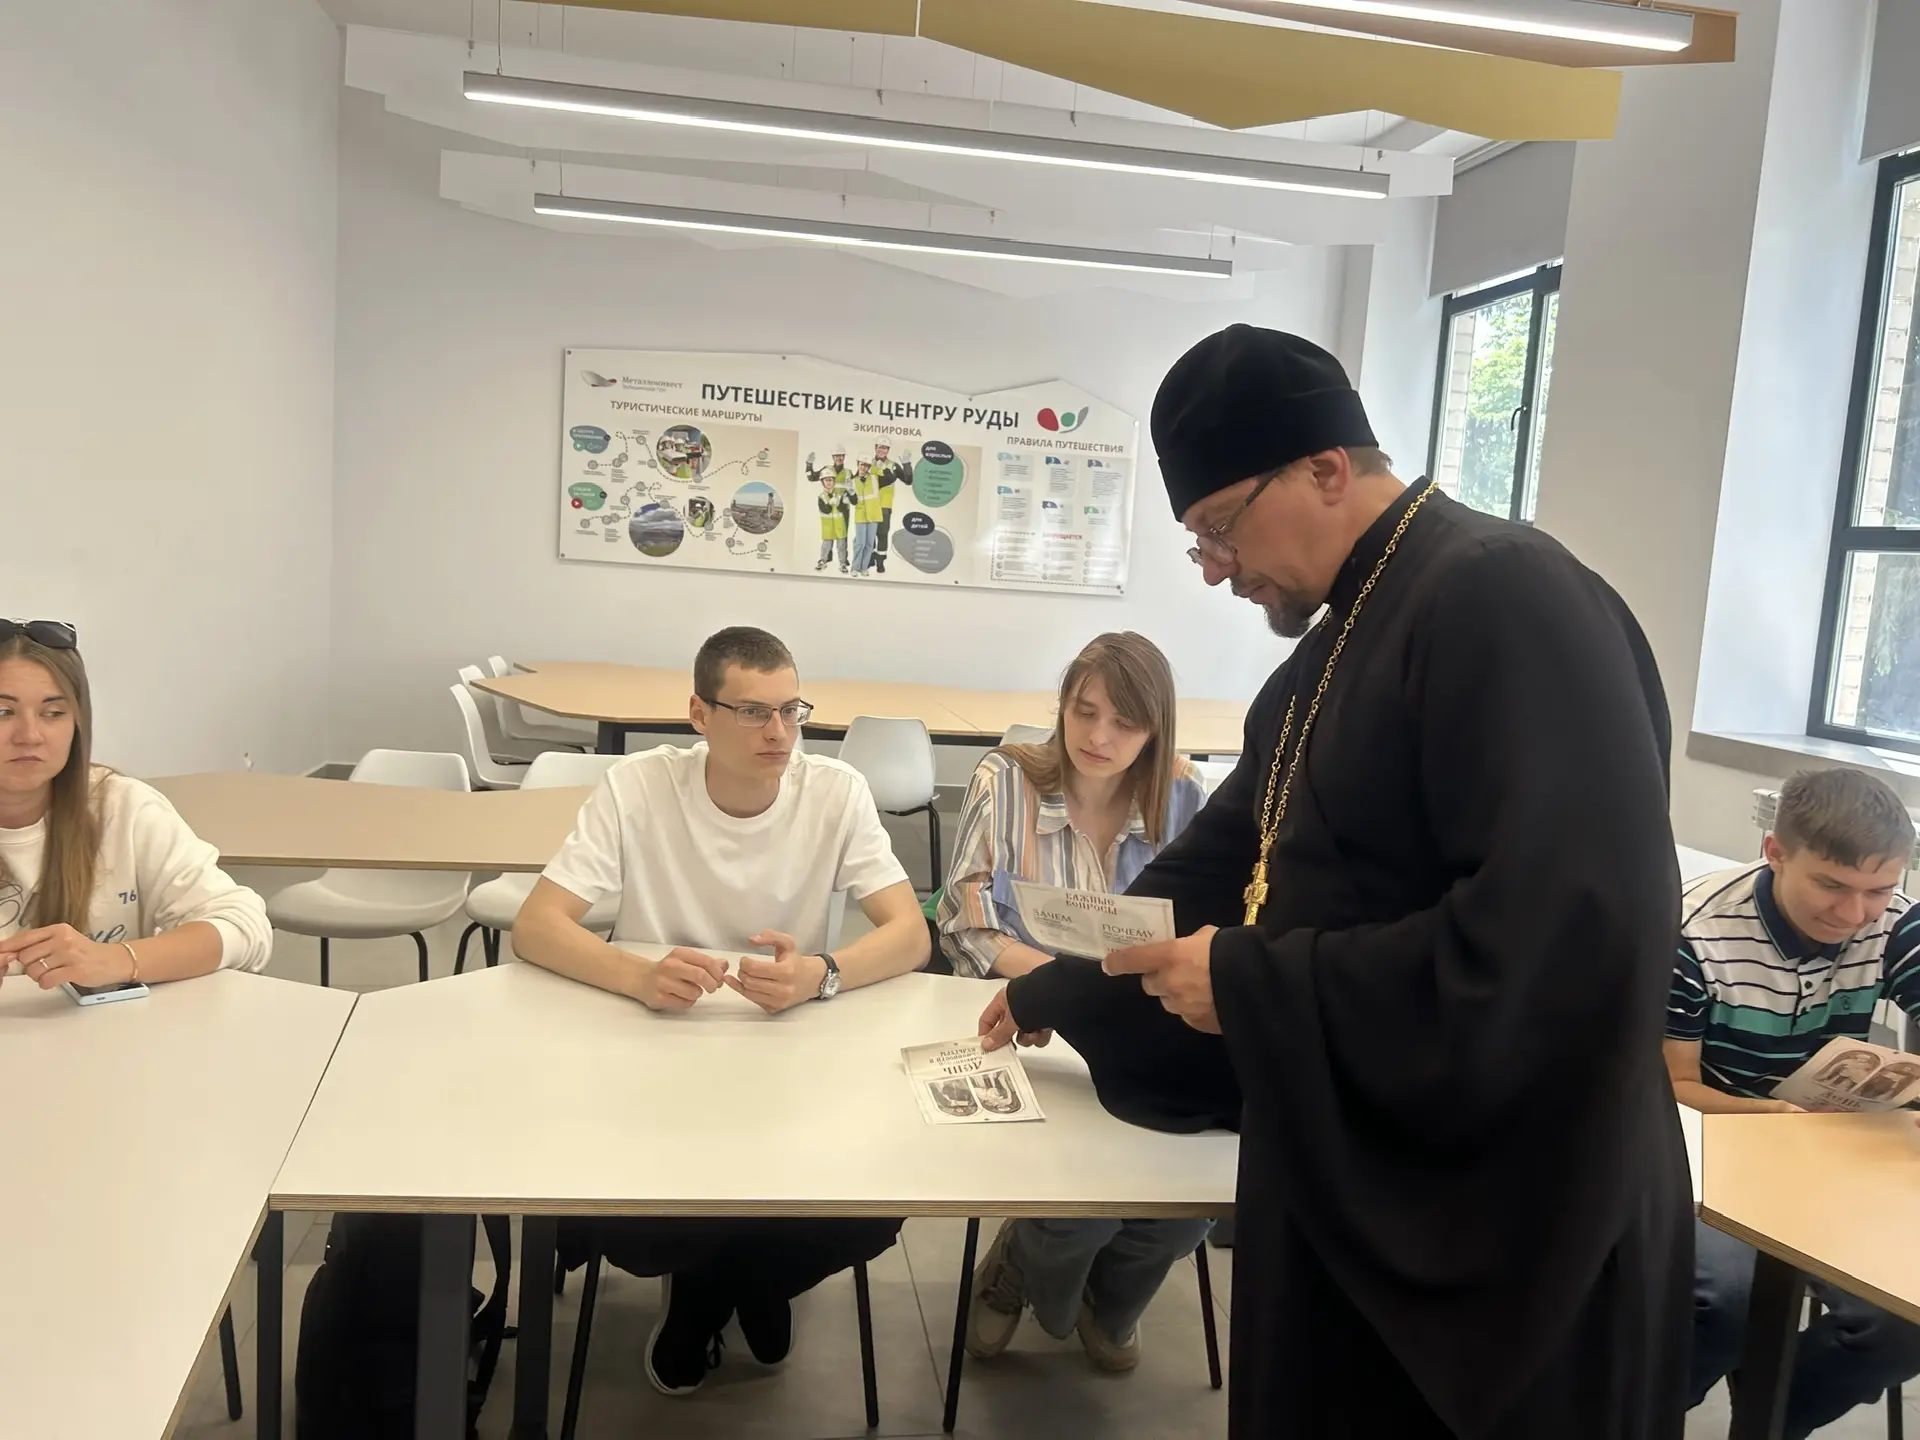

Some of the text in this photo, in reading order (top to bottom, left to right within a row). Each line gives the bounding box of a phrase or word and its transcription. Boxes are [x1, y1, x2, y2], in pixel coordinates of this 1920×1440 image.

[610, 400, 763, 422] ТУРИСТИЧЕСКИЕ МАРШРУТЫ
[701, 383, 1020, 430] ПУТЕШЕСТВИЕ К ЦЕНТРУ РУДЫ
[853, 423, 922, 438] ЭКИПИРОВКА
[1007, 436, 1124, 453] ПРАВИЛА ПУТЕШЕСТВИЯ
[118, 889, 137, 905] 76
[1065, 892, 1115, 906] ВАЖНЫЕ
[1065, 900, 1118, 915] ВОПРОСЫ
[1033, 908, 1072, 923] ЗАЧЕМ
[1102, 923, 1156, 938] ПОЧЕМУ
